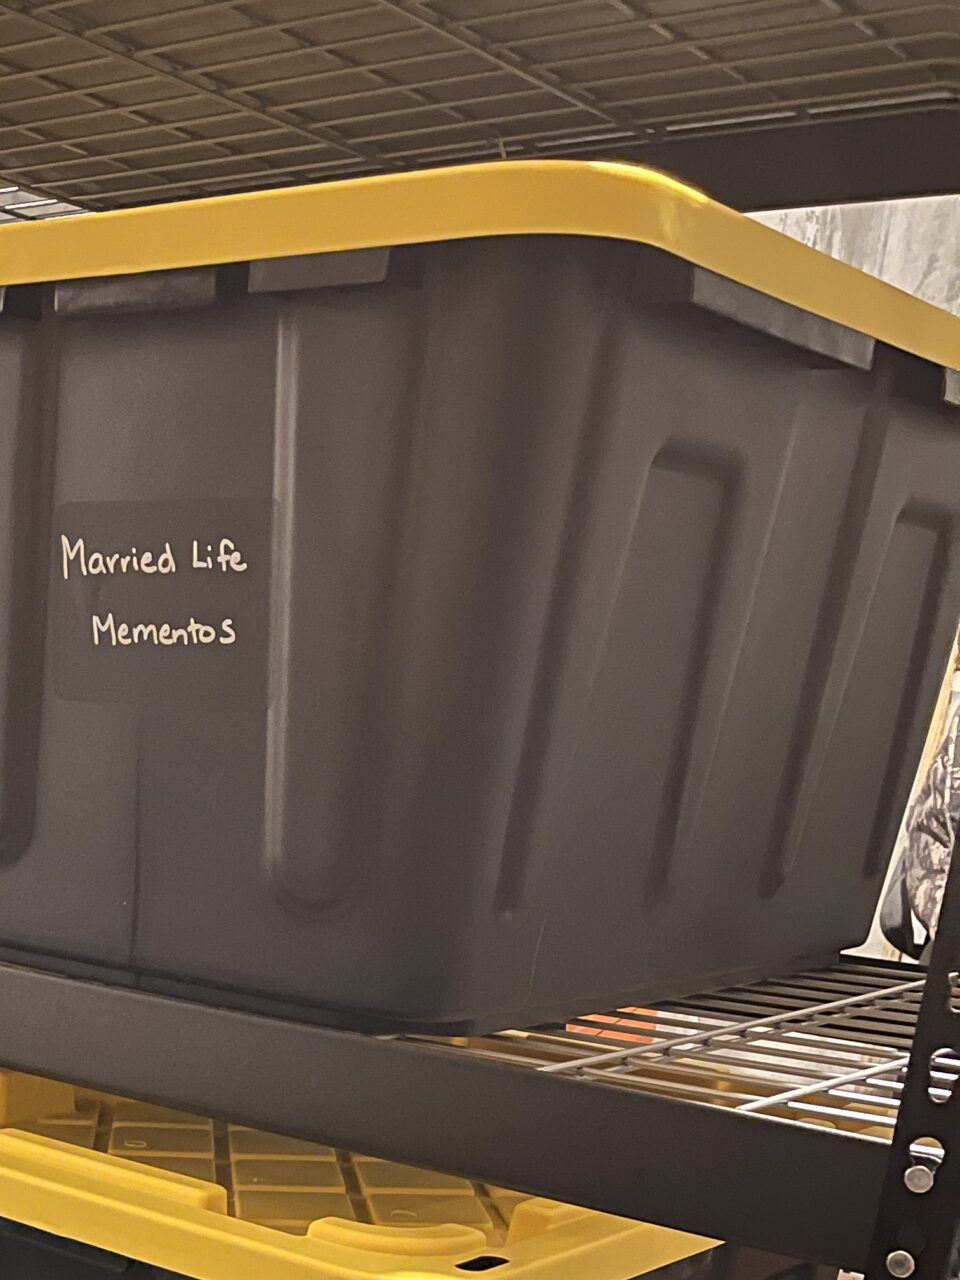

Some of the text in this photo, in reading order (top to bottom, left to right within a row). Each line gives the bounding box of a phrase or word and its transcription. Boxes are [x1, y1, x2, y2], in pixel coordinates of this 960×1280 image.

[61, 534, 248, 579] Married Life
[92, 612, 236, 646] Mementos
